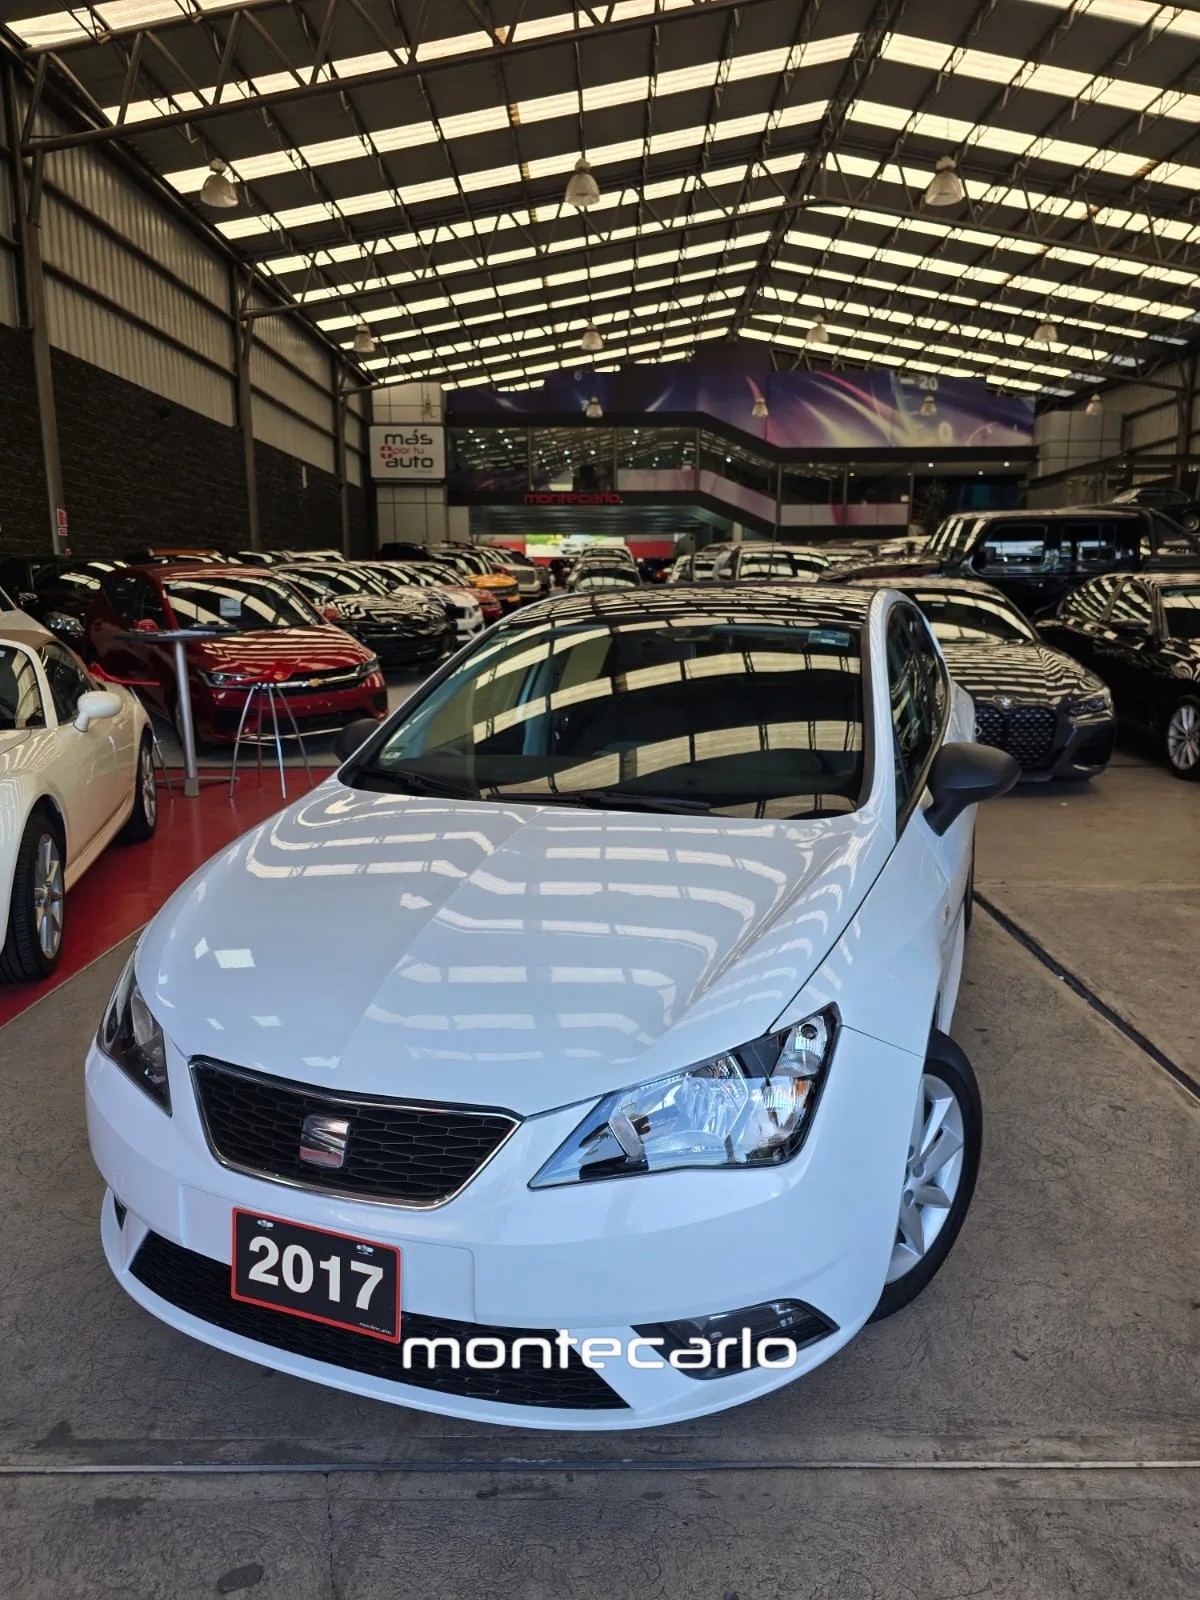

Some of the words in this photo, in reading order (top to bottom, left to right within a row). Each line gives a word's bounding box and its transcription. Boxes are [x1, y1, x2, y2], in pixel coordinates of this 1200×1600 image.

[384, 429, 433, 445] más
[385, 456, 434, 468] auto
[524, 493, 621, 505] montecarlo
[248, 1236, 384, 1311] 2017
